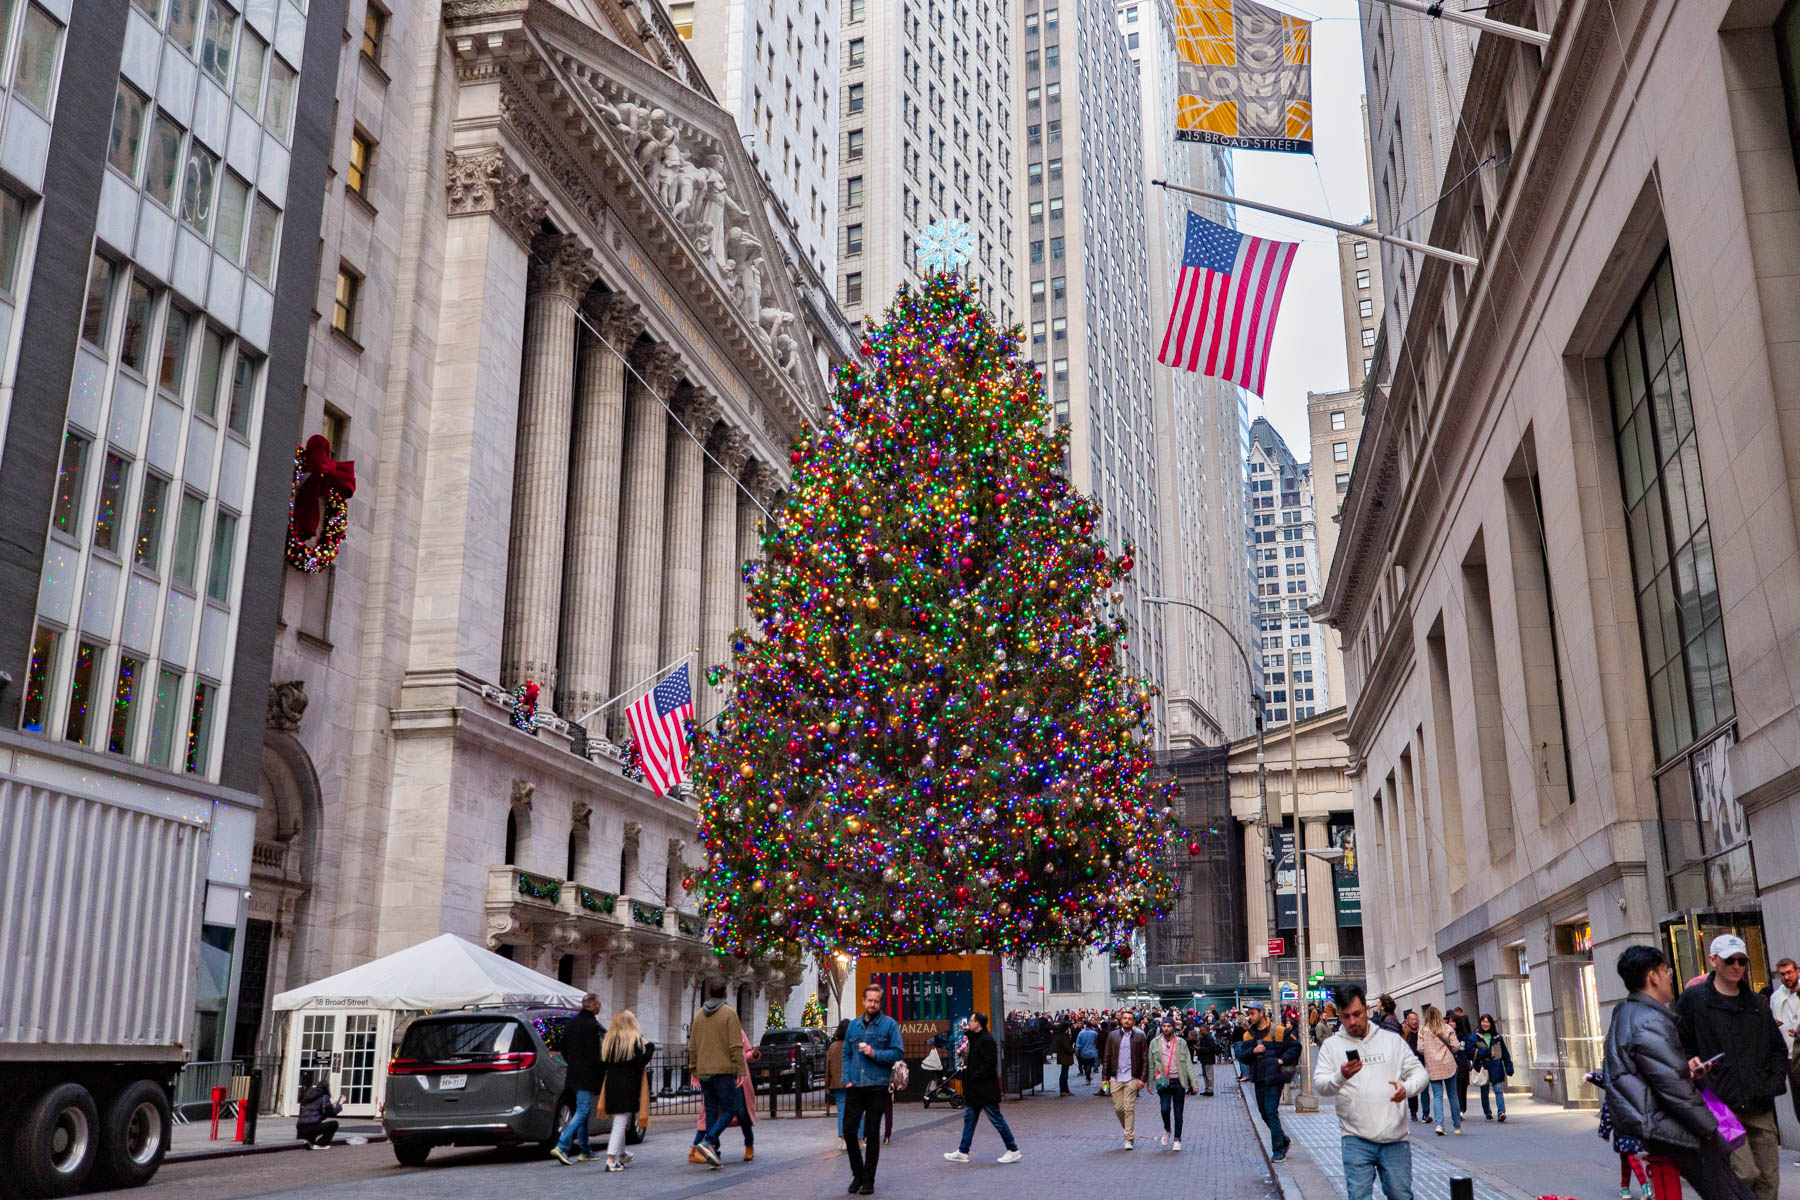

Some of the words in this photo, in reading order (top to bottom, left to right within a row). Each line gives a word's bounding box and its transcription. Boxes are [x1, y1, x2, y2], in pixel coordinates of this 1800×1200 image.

[1179, 66, 1309, 97] TOWN
[1187, 130, 1200, 141] 15
[1205, 132, 1249, 148] BROAD
[1254, 138, 1300, 151] STREET
[629, 247, 649, 284] NEW
[653, 279, 675, 321] YORK
[680, 310, 703, 353] STOCK
[913, 985, 954, 996] Lgtig
[325, 998, 346, 1006] Broad
[347, 998, 369, 1006] Street
[898, 1023, 938, 1034] ANZAA
